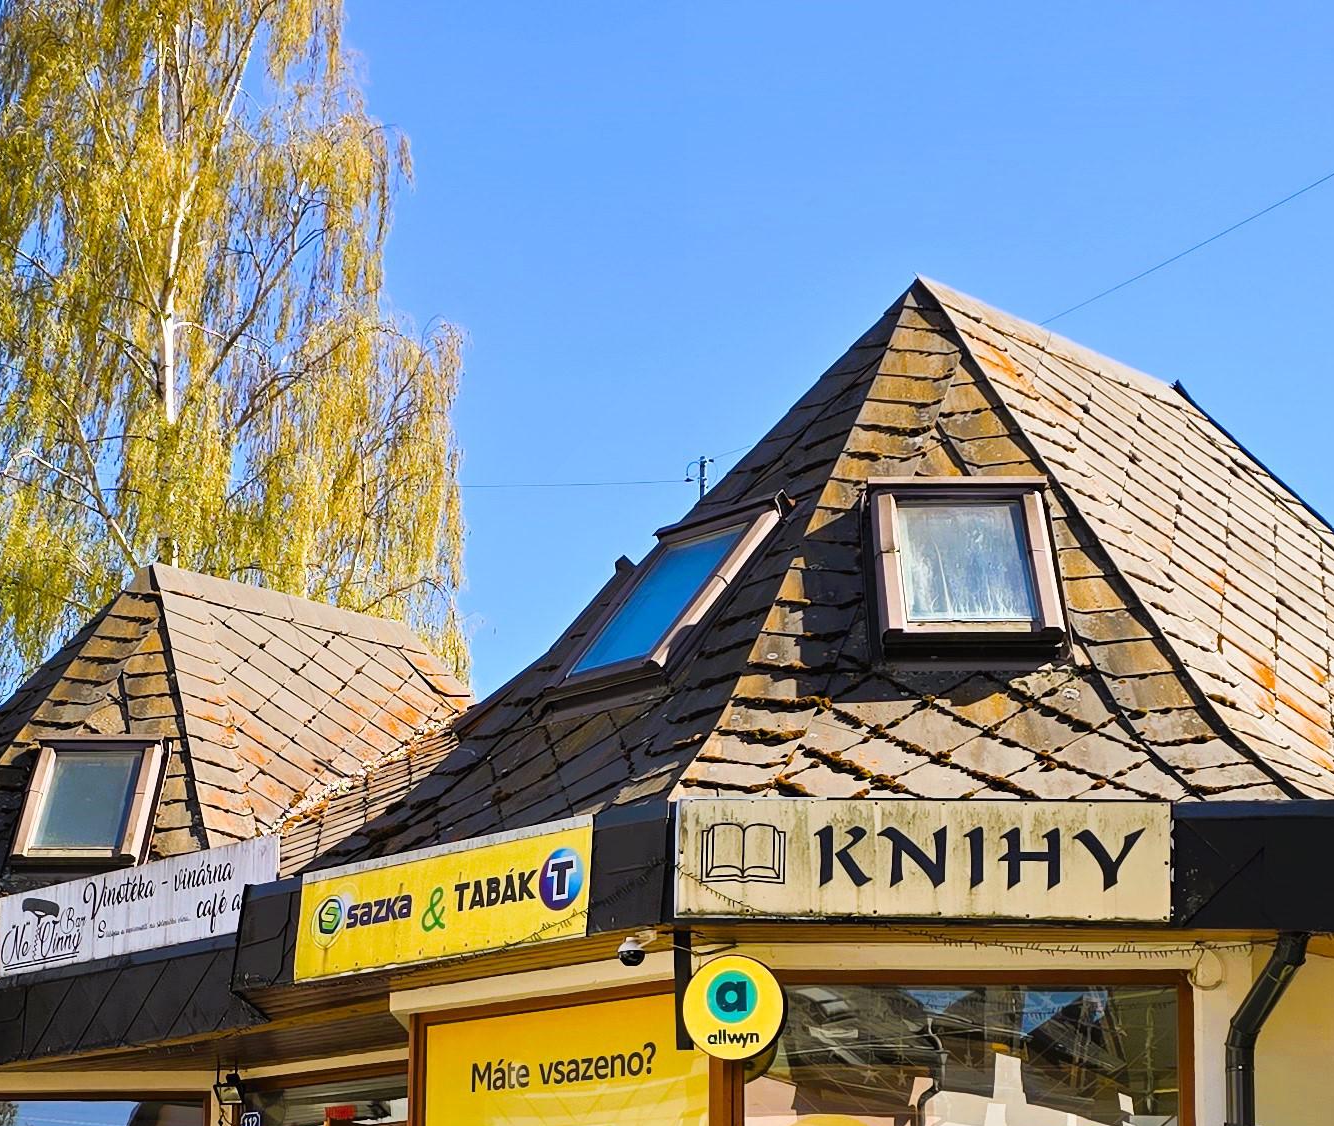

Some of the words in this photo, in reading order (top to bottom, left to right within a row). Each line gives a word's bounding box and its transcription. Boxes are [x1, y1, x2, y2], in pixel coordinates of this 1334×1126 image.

[815, 823, 1148, 891] KNIHY
[83, 874, 155, 920] Vinotéka
[174, 860, 235, 892] vinárna
[196, 890, 227, 933] café
[421, 886, 446, 932] &
[454, 868, 538, 911] TABÁK
[60, 907, 86, 935] Bar
[708, 1029, 759, 1049] allwyn
[470, 1059, 529, 1092] Máte
[539, 1041, 657, 1086] vsazeno?
